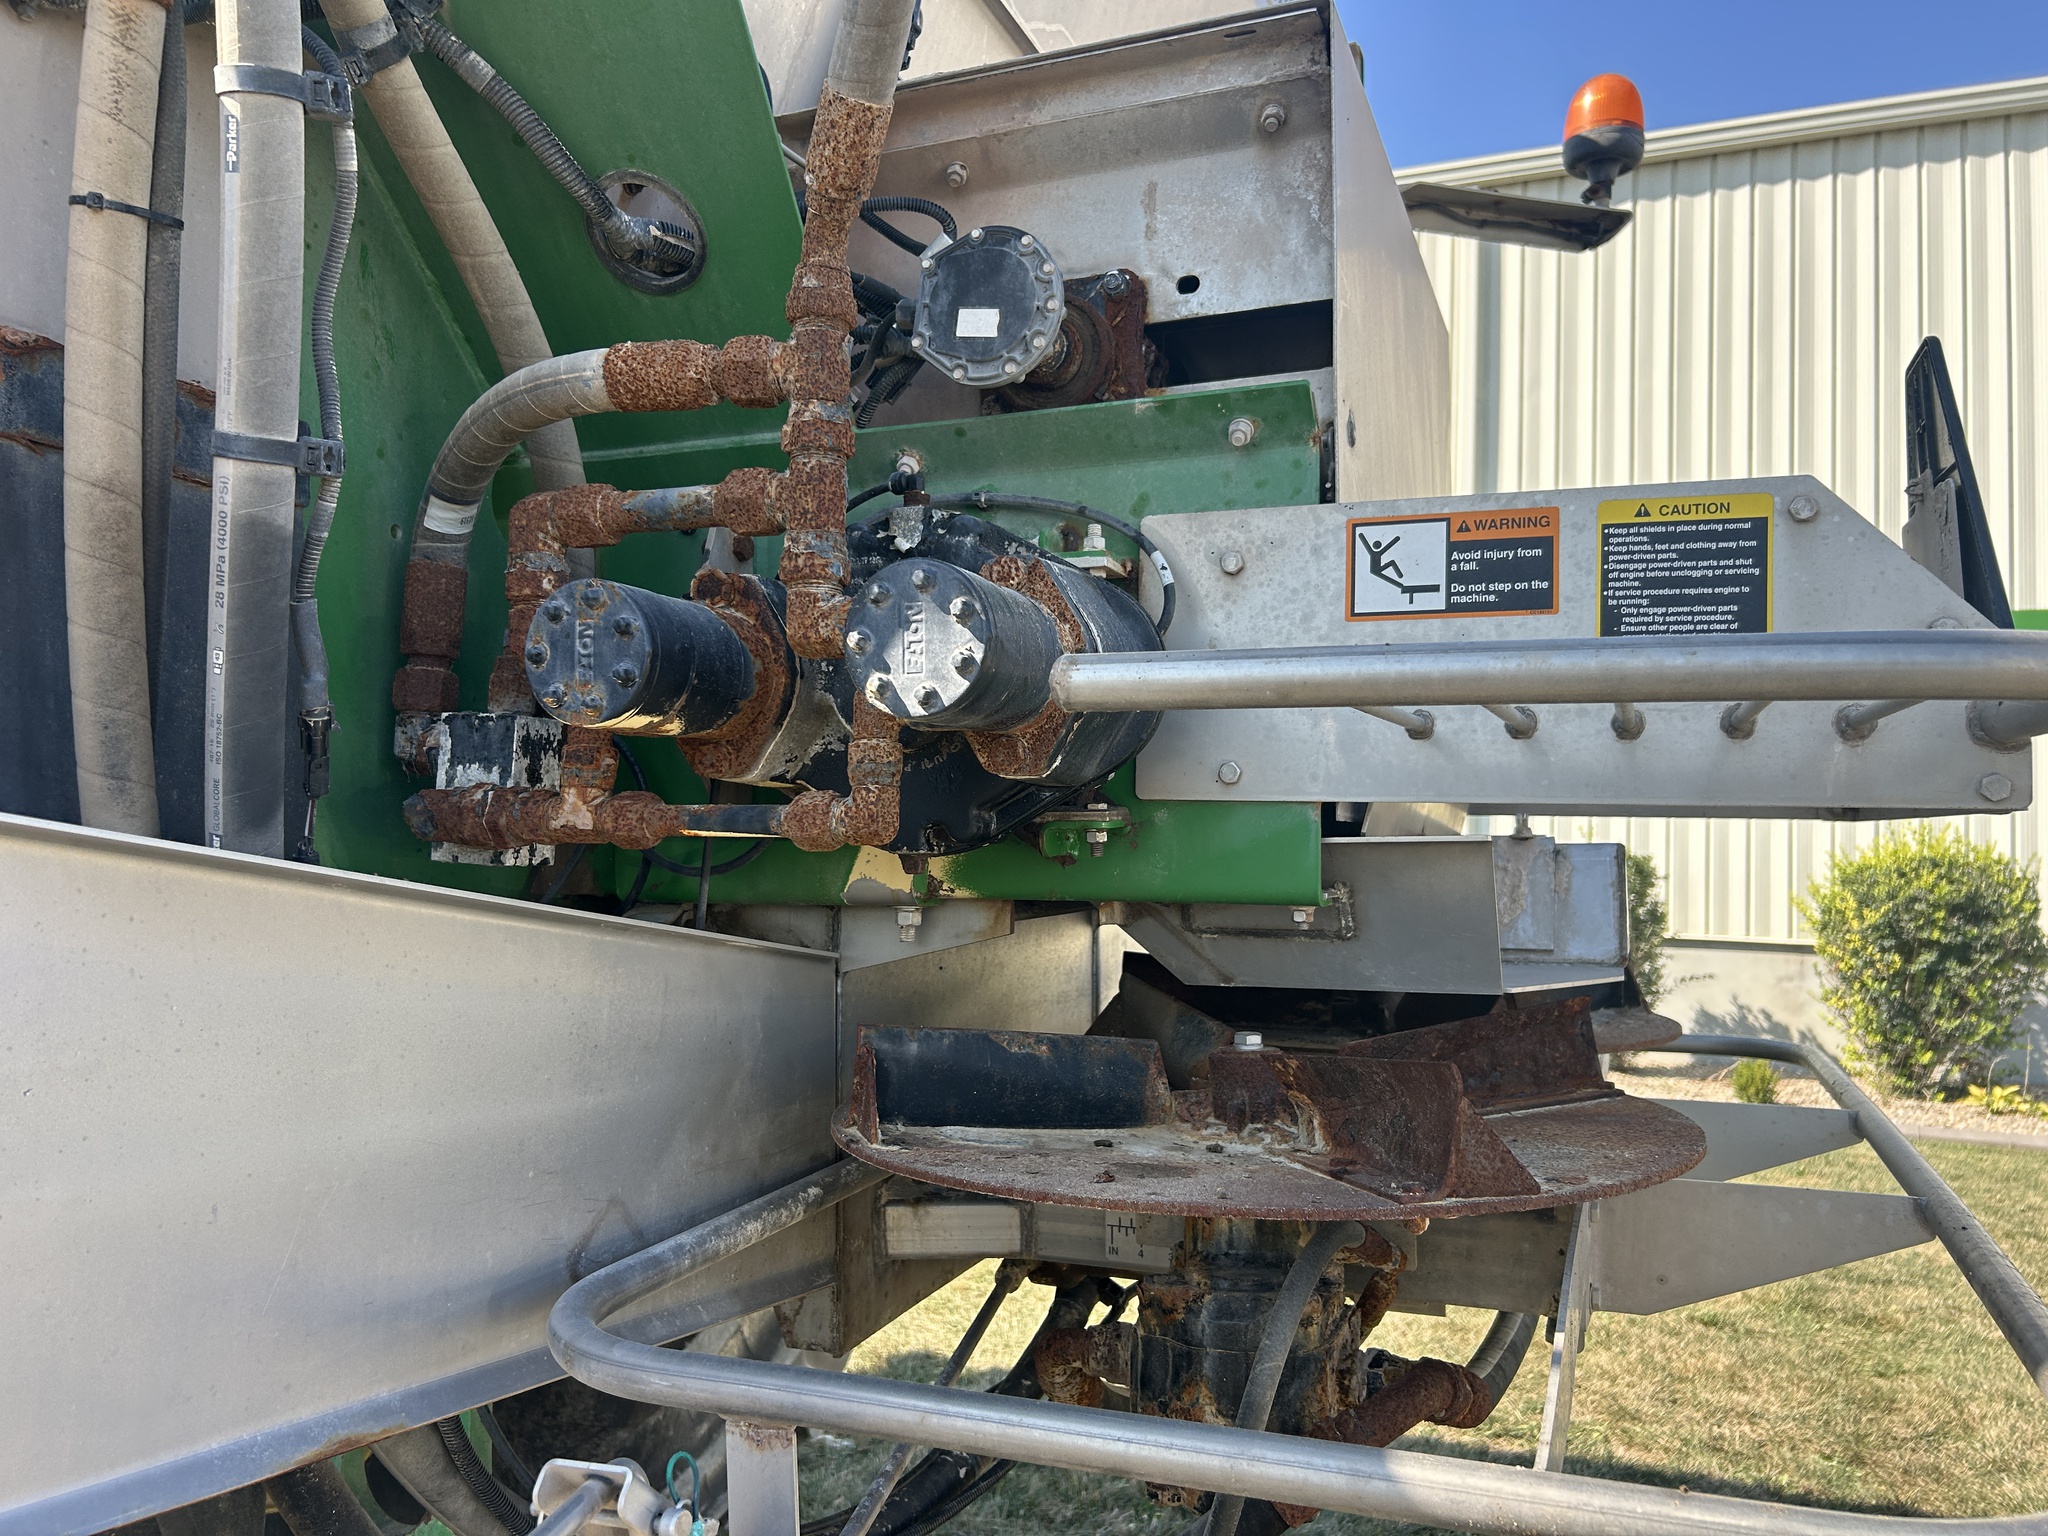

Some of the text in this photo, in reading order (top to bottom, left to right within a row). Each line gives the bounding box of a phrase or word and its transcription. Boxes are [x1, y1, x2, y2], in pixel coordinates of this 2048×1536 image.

[226, 115, 238, 171] Parker
[1659, 502, 1730, 516] CAUTION
[1474, 515, 1550, 531] WARNING
[1609, 527, 1627, 535] Keep
[1640, 525, 1666, 533] shields
[1698, 523, 1722, 531] during
[1725, 522, 1751, 530] normal
[215, 476, 231, 609] 28 MPa (4000 PSI)
[1609, 535, 1649, 543] operations.
[1609, 545, 1627, 553] Keep
[1629, 544, 1653, 552] hands,
[1686, 541, 1716, 550] clothing
[1451, 548, 1542, 561] Avoid injury from
[1451, 562, 1479, 571] a fall.
[1609, 562, 1646, 570] Disengage
[1649, 561, 1696, 569] power-driven
[1620, 571, 1644, 579] engine
[1672, 569, 1712, 577] unclogging
[1451, 583, 1465, 592] Do
[1468, 583, 1486, 591] not
[1488, 582, 1512, 592] step
[1531, 581, 1549, 589] the
[1643, 588, 1680, 596] procedure
[1682, 587, 1712, 595] requires
[1451, 593, 1498, 603] machine.
[1619, 598, 1649, 606] running:
[1621, 604, 1738, 615] Only engage power-driven parts
[1622, 615, 1653, 623] required
[1694, 613, 1734, 622] procedure.
[1669, 623, 1694, 632] people
[903, 602, 924, 675] EATON
[1109, 1246, 1118, 1255] IN
[1138, 1250, 1144, 1258] 4
